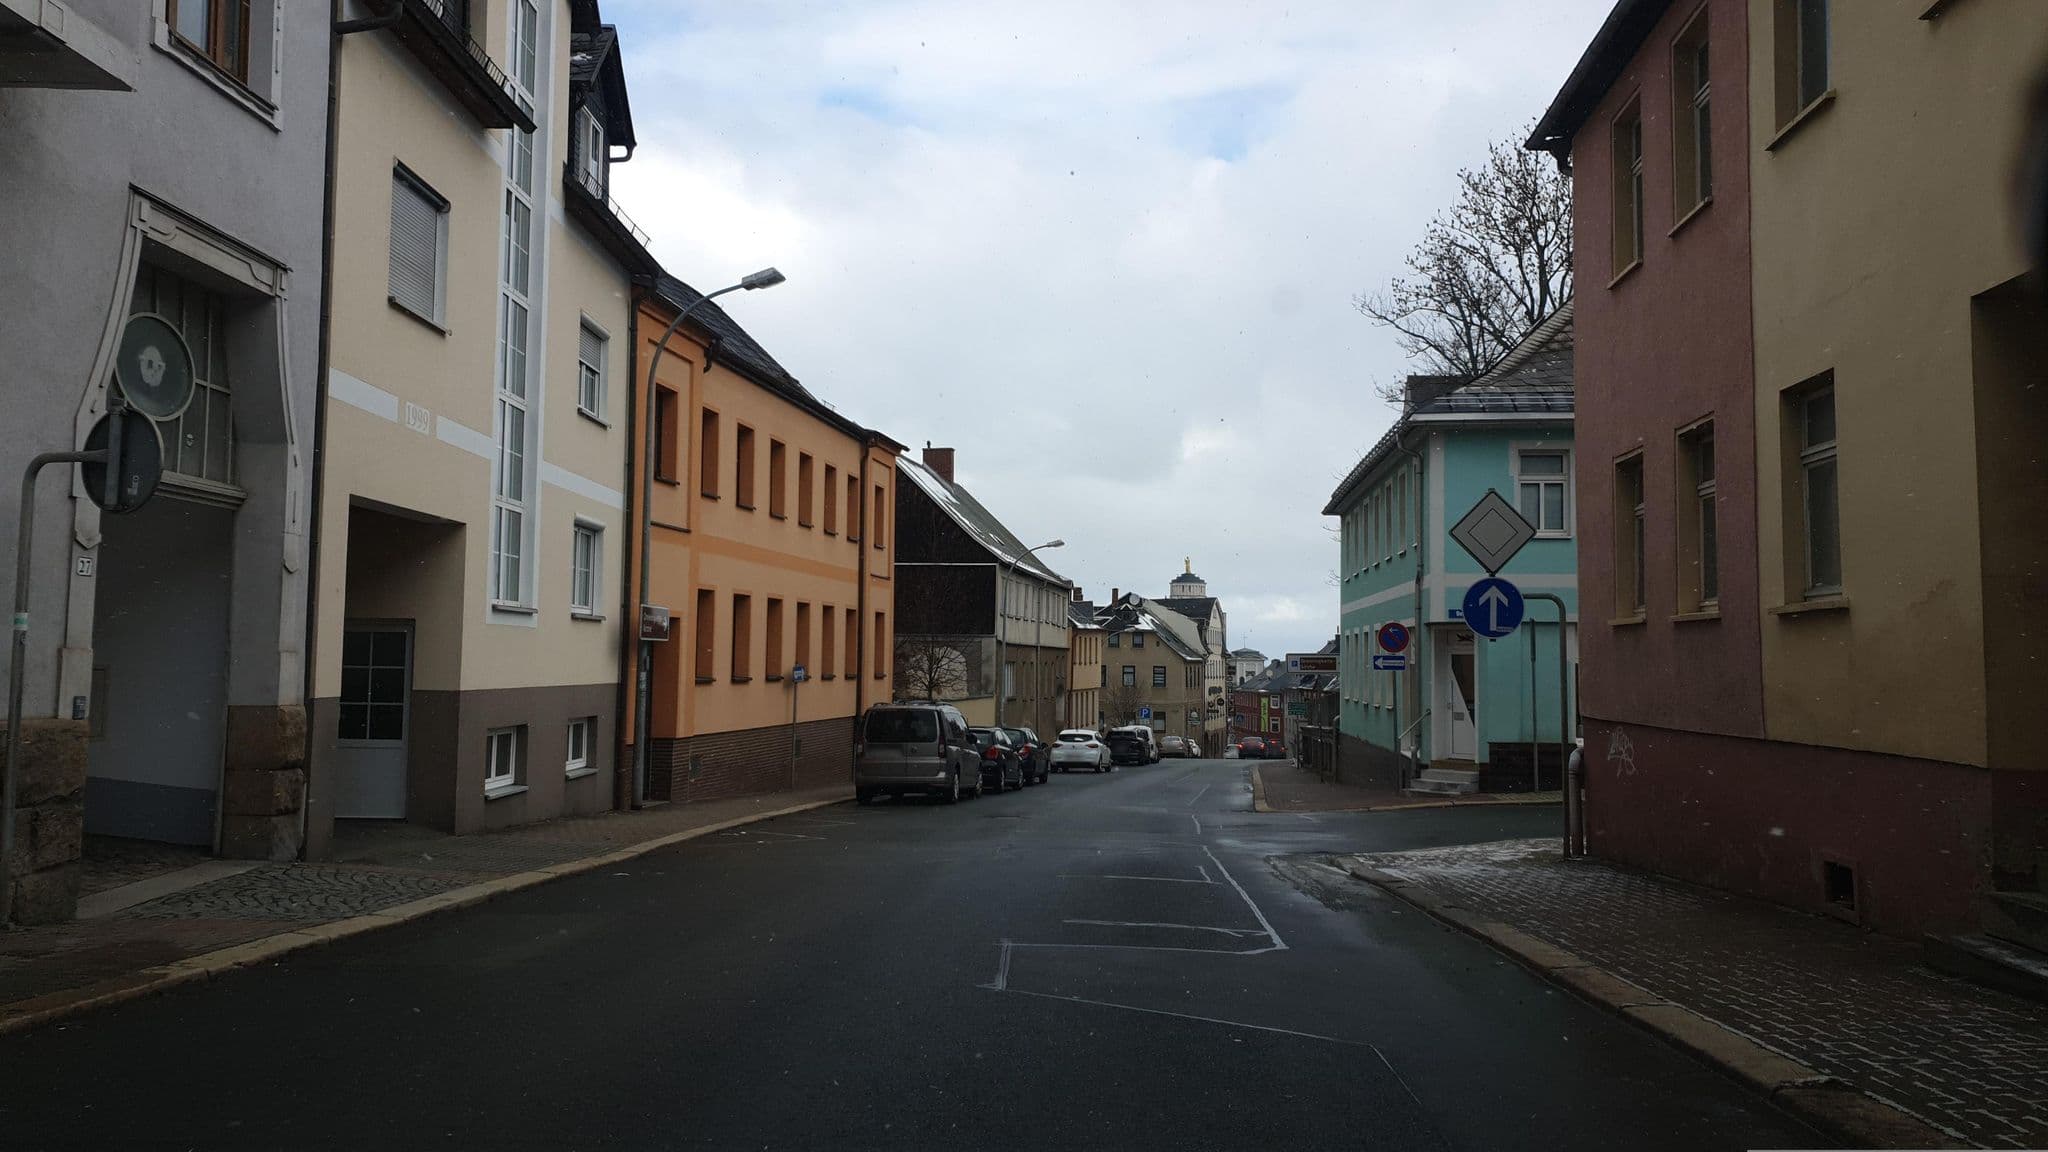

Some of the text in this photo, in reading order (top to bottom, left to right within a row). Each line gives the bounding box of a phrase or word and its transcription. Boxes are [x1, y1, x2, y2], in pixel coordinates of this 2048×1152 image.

[407, 403, 430, 433] 1999
[80, 560, 91, 574] 27
[1142, 708, 1149, 718] P
